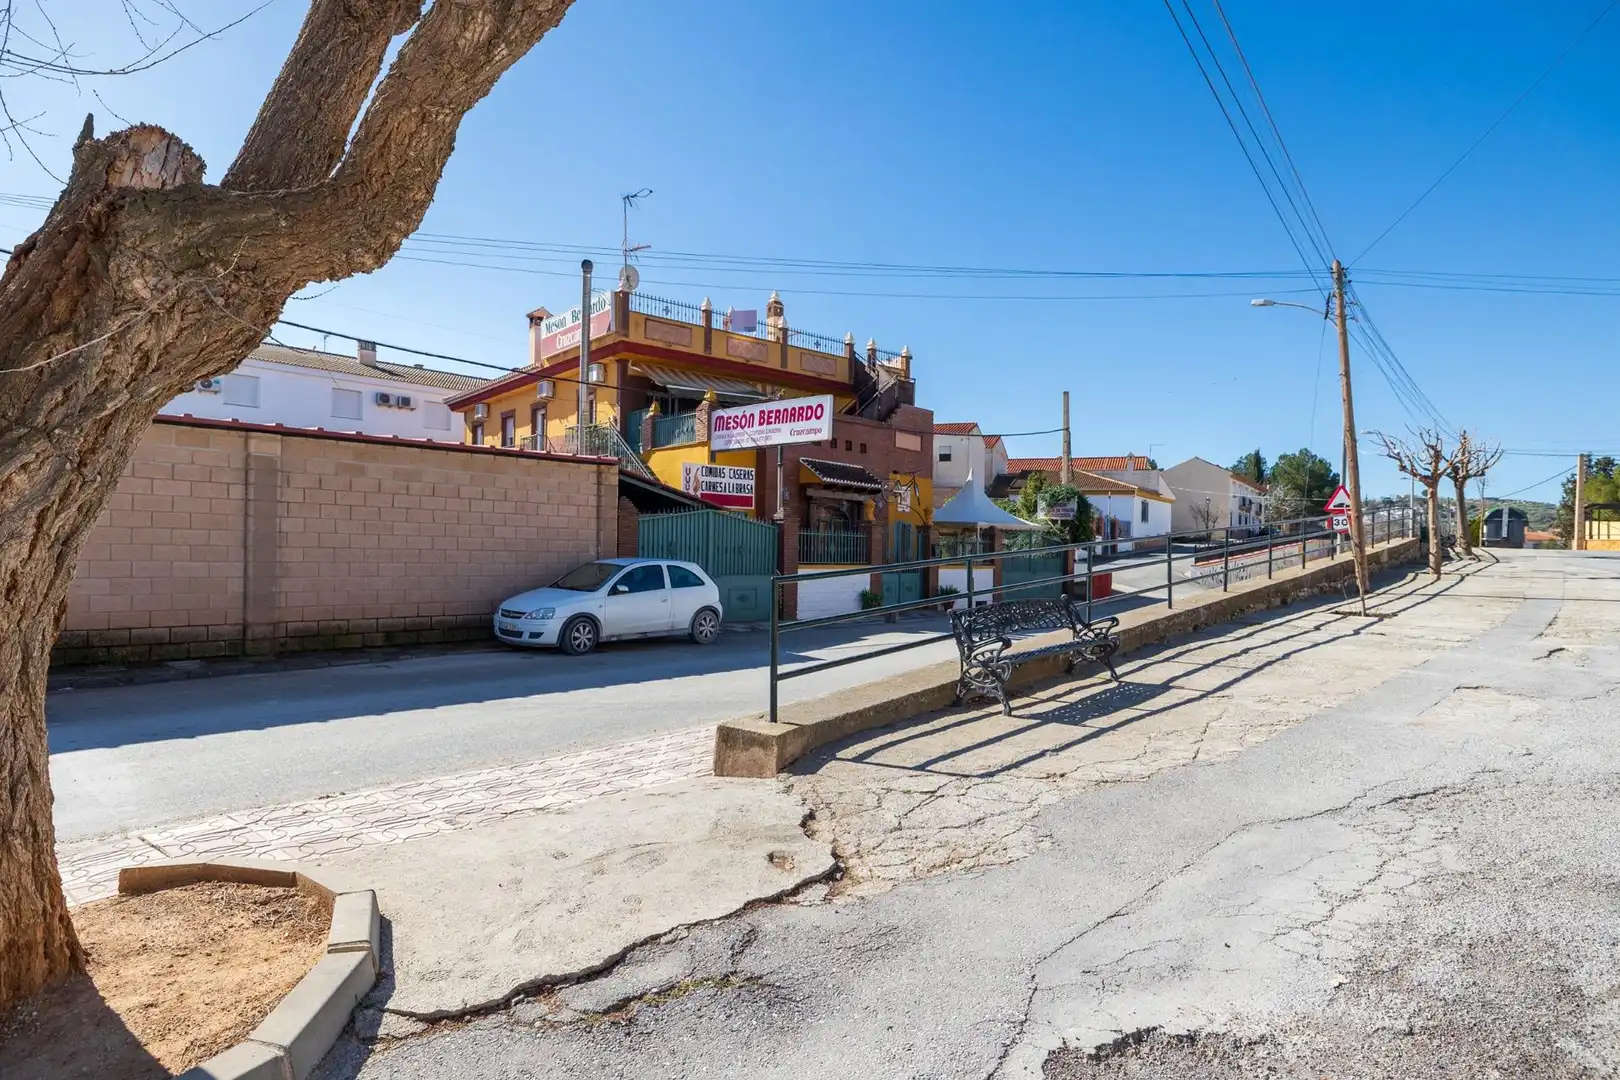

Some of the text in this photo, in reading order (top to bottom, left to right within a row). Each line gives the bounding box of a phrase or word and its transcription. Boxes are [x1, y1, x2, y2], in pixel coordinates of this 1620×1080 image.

[571, 296, 606, 324] Berdo
[714, 403, 824, 432] MESÓN BERNARDO
[789, 427, 822, 437] Cruzcampo
[701, 466, 754, 481] COMIDAS CASERAS
[701, 480, 723, 493] CARNES
[735, 482, 754, 495] BRASA
[1334, 518, 1348, 527] 30
